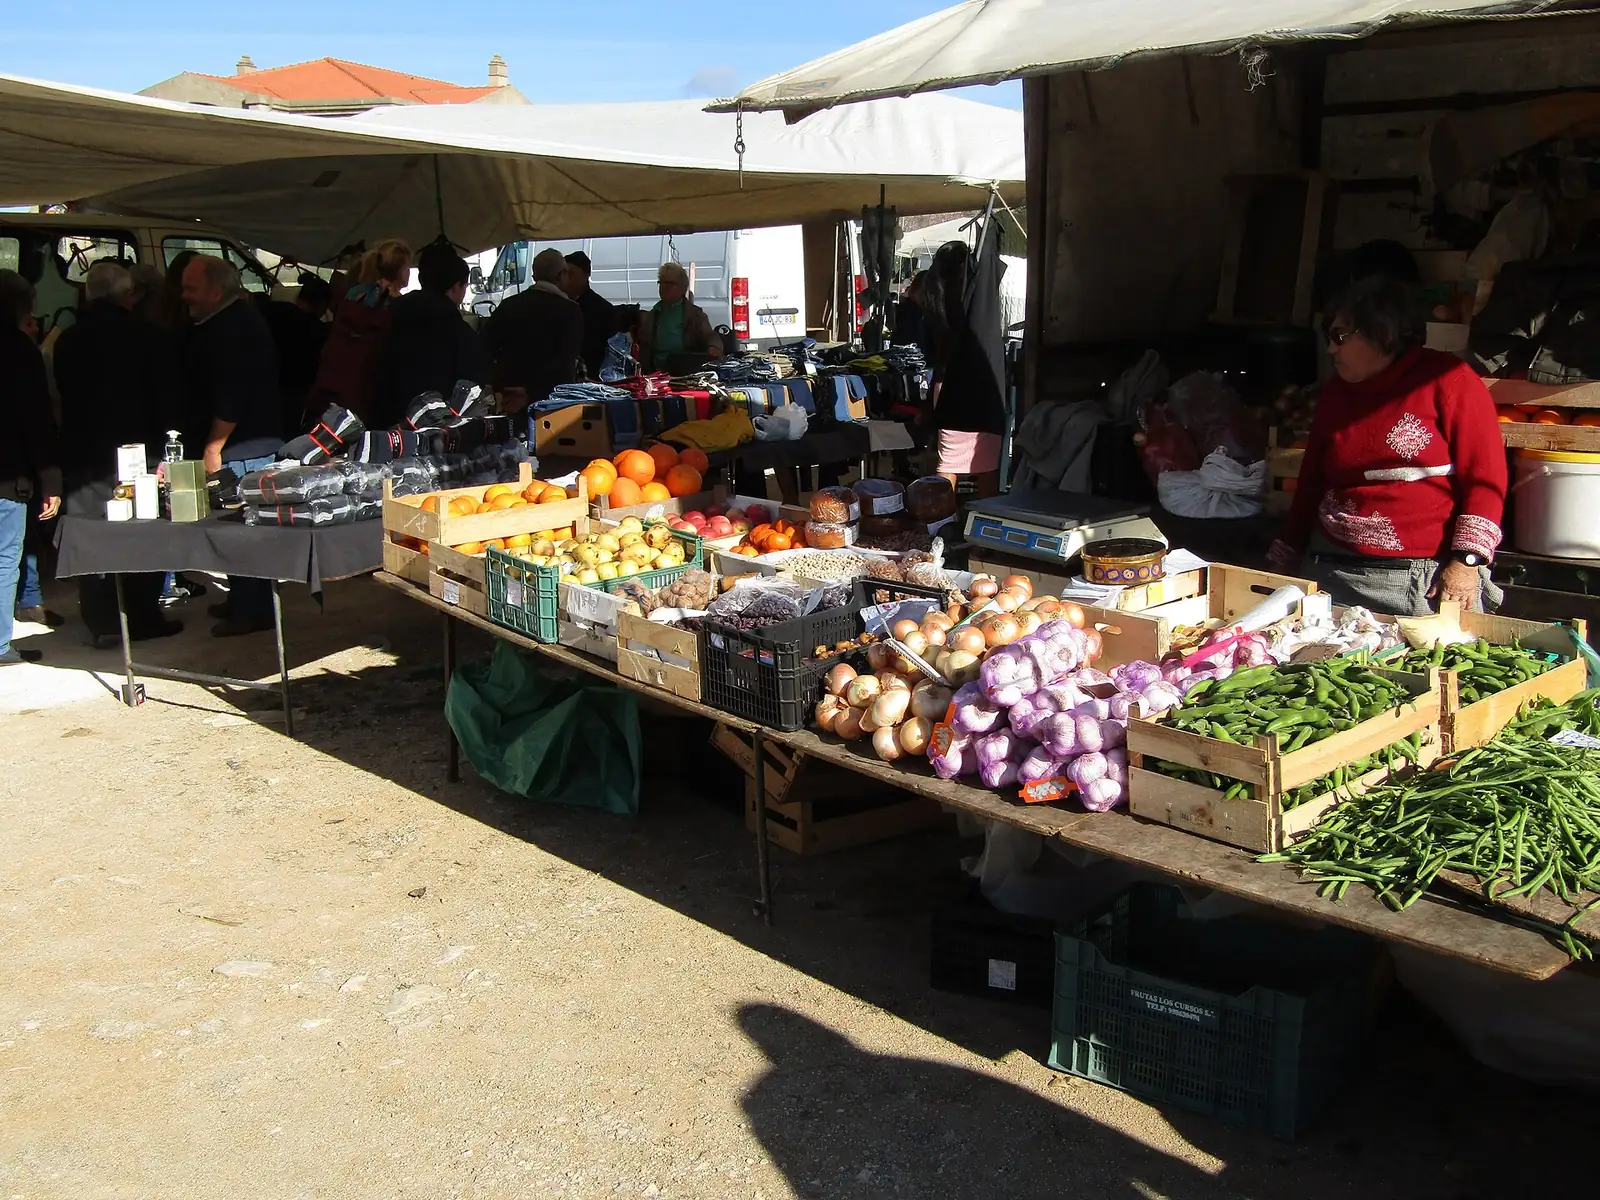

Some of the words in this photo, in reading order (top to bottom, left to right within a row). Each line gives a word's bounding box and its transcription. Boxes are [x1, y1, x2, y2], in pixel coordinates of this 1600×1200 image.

[1130, 989, 1158, 1002] FRUTAS
[1158, 996, 1174, 1007] LOS
[1174, 1001, 1203, 1015] CURSOS
